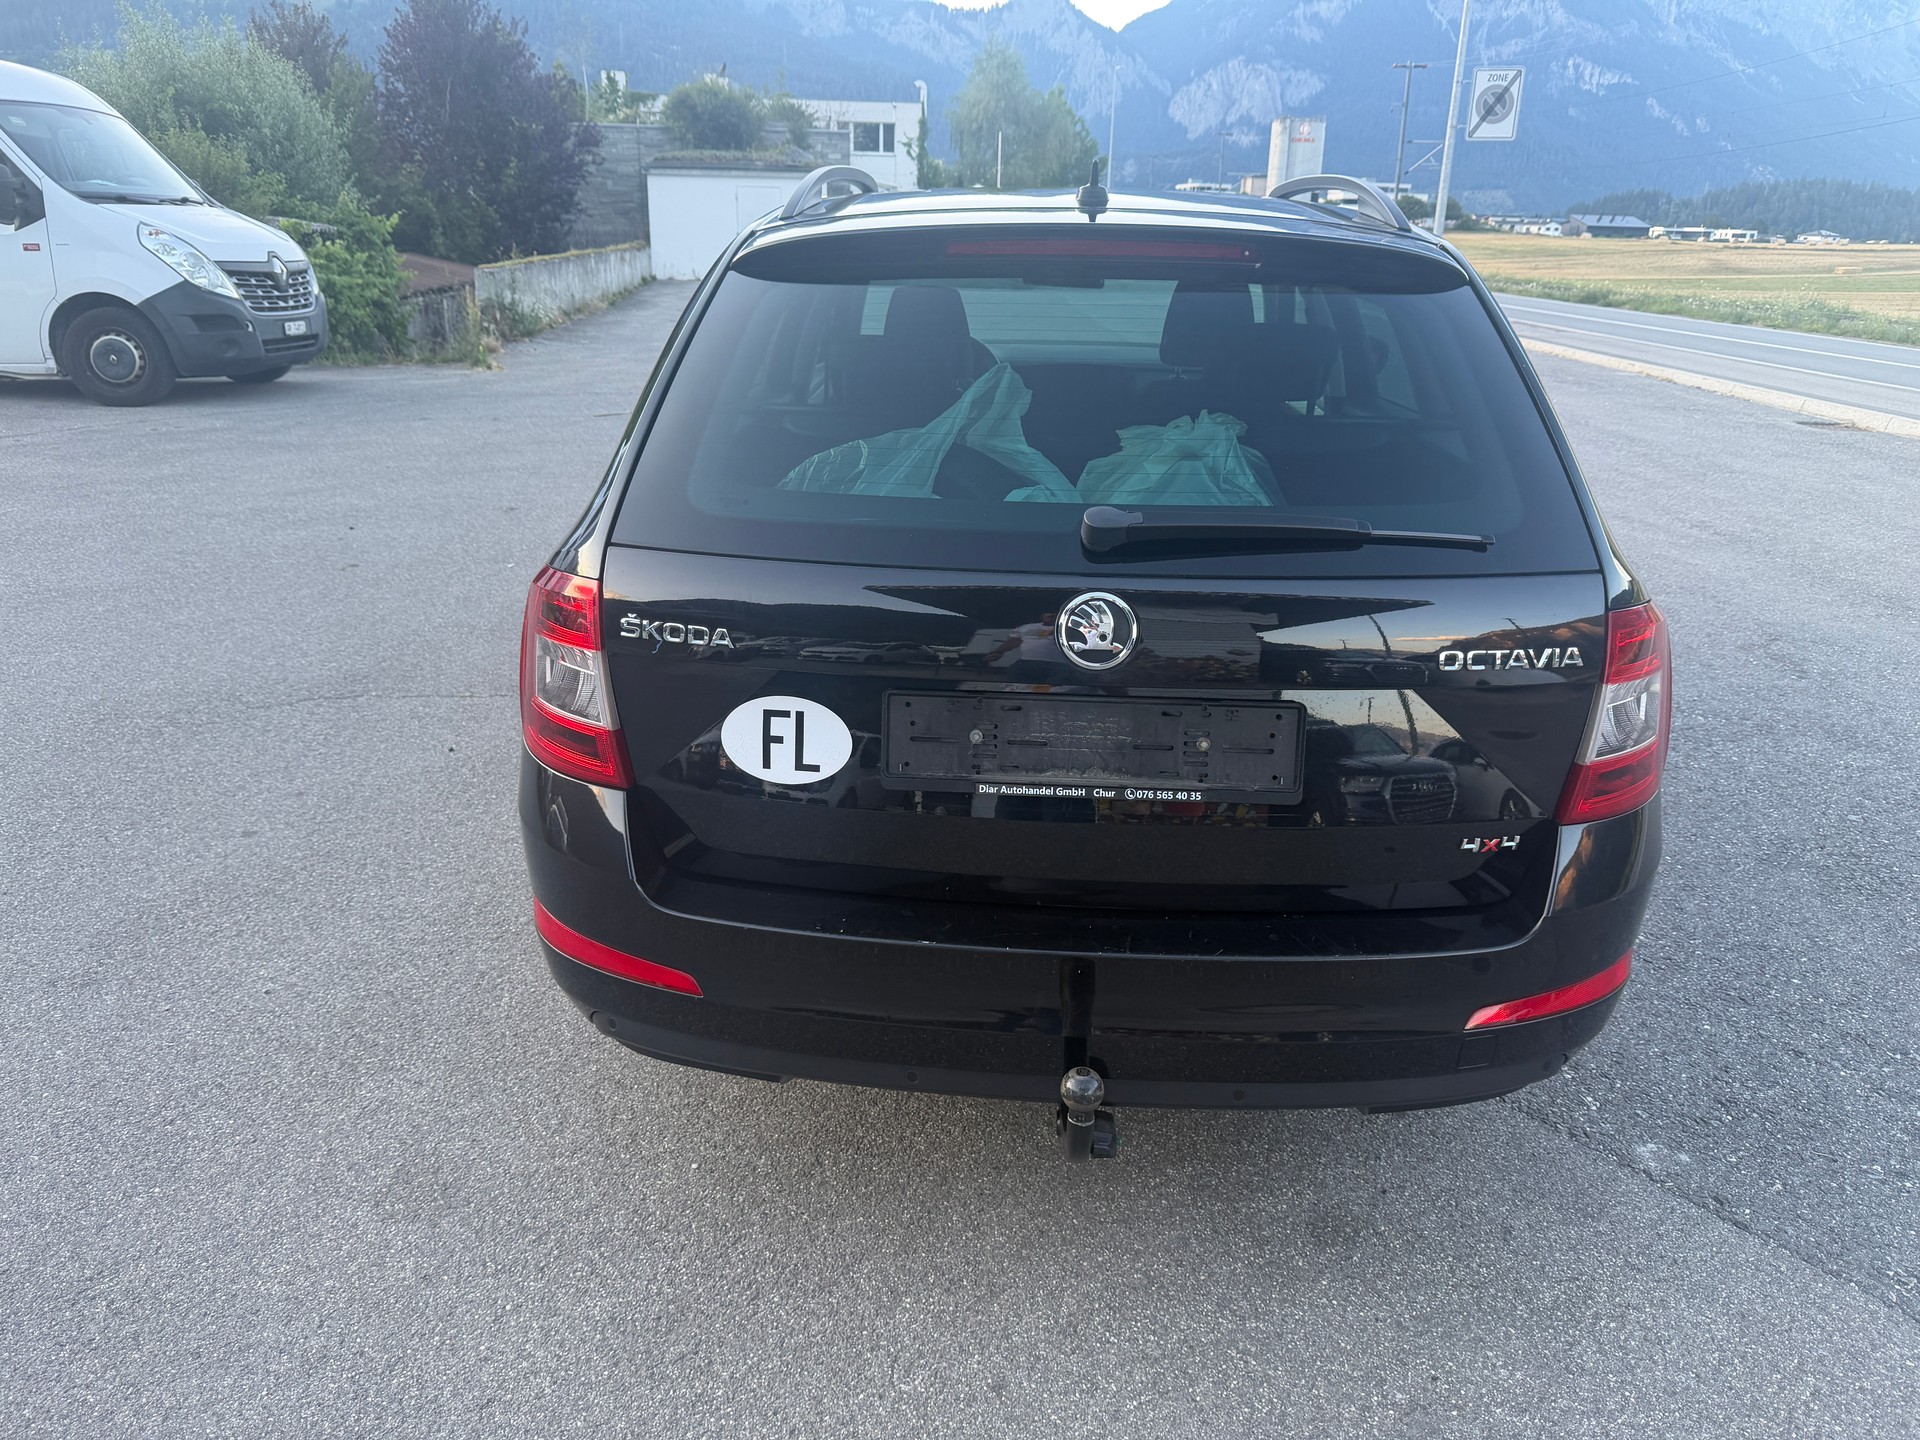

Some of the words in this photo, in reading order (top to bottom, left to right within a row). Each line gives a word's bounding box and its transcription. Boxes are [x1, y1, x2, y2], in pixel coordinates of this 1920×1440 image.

[1487, 73, 1510, 82] ZONE
[620, 613, 734, 649] ŠKODA
[1438, 646, 1584, 671] OCTAVIA
[762, 708, 821, 773] FL
[979, 784, 998, 794] Diar
[1000, 785, 1054, 796] Autohandel
[1056, 787, 1086, 797] GmbH
[1093, 788, 1116, 798] Chur
[1136, 790, 1154, 799] 076
[1156, 790, 1174, 800] 565
[1175, 791, 1188, 800] 40
[1189, 792, 1202, 801] 35
[1460, 835, 1521, 853] 4x4
